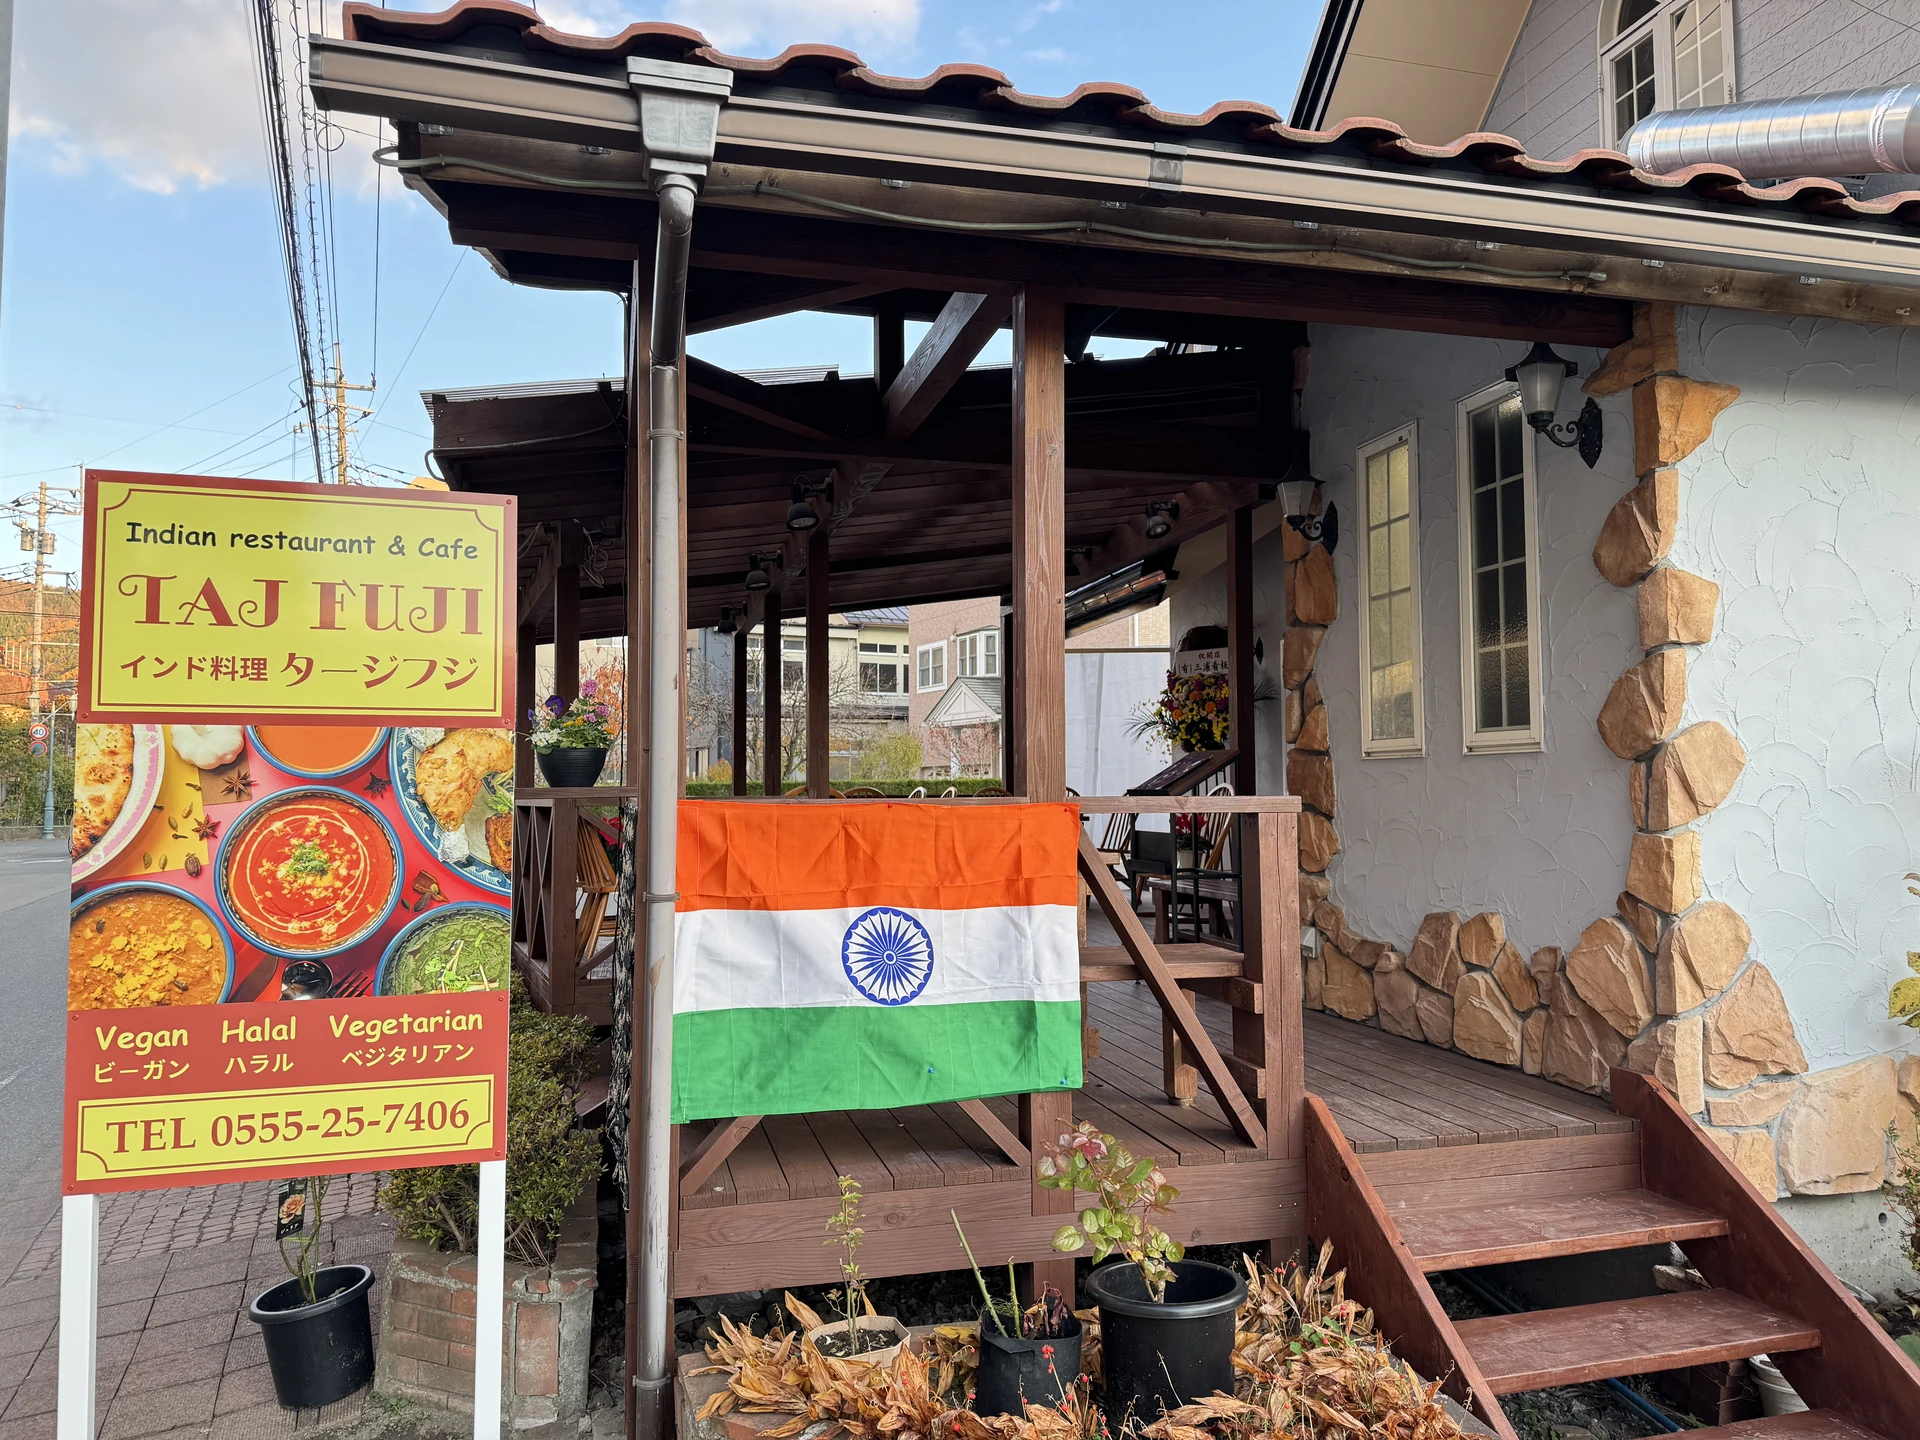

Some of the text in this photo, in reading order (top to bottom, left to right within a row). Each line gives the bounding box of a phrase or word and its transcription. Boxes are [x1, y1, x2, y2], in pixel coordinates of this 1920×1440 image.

[125, 521, 478, 560] Indian restaurant & Cafe
[117, 574, 483, 635] TAJ FUJI
[120, 652, 479, 691] インド料理 タージフジ
[33, 728, 44, 736] 40
[95, 1009, 483, 1056] Vegan Halal Vegetarian
[94, 1042, 474, 1083] ビーガン ハラル ベジタリアン
[106, 1098, 470, 1154] TEL 0555-25-7406
